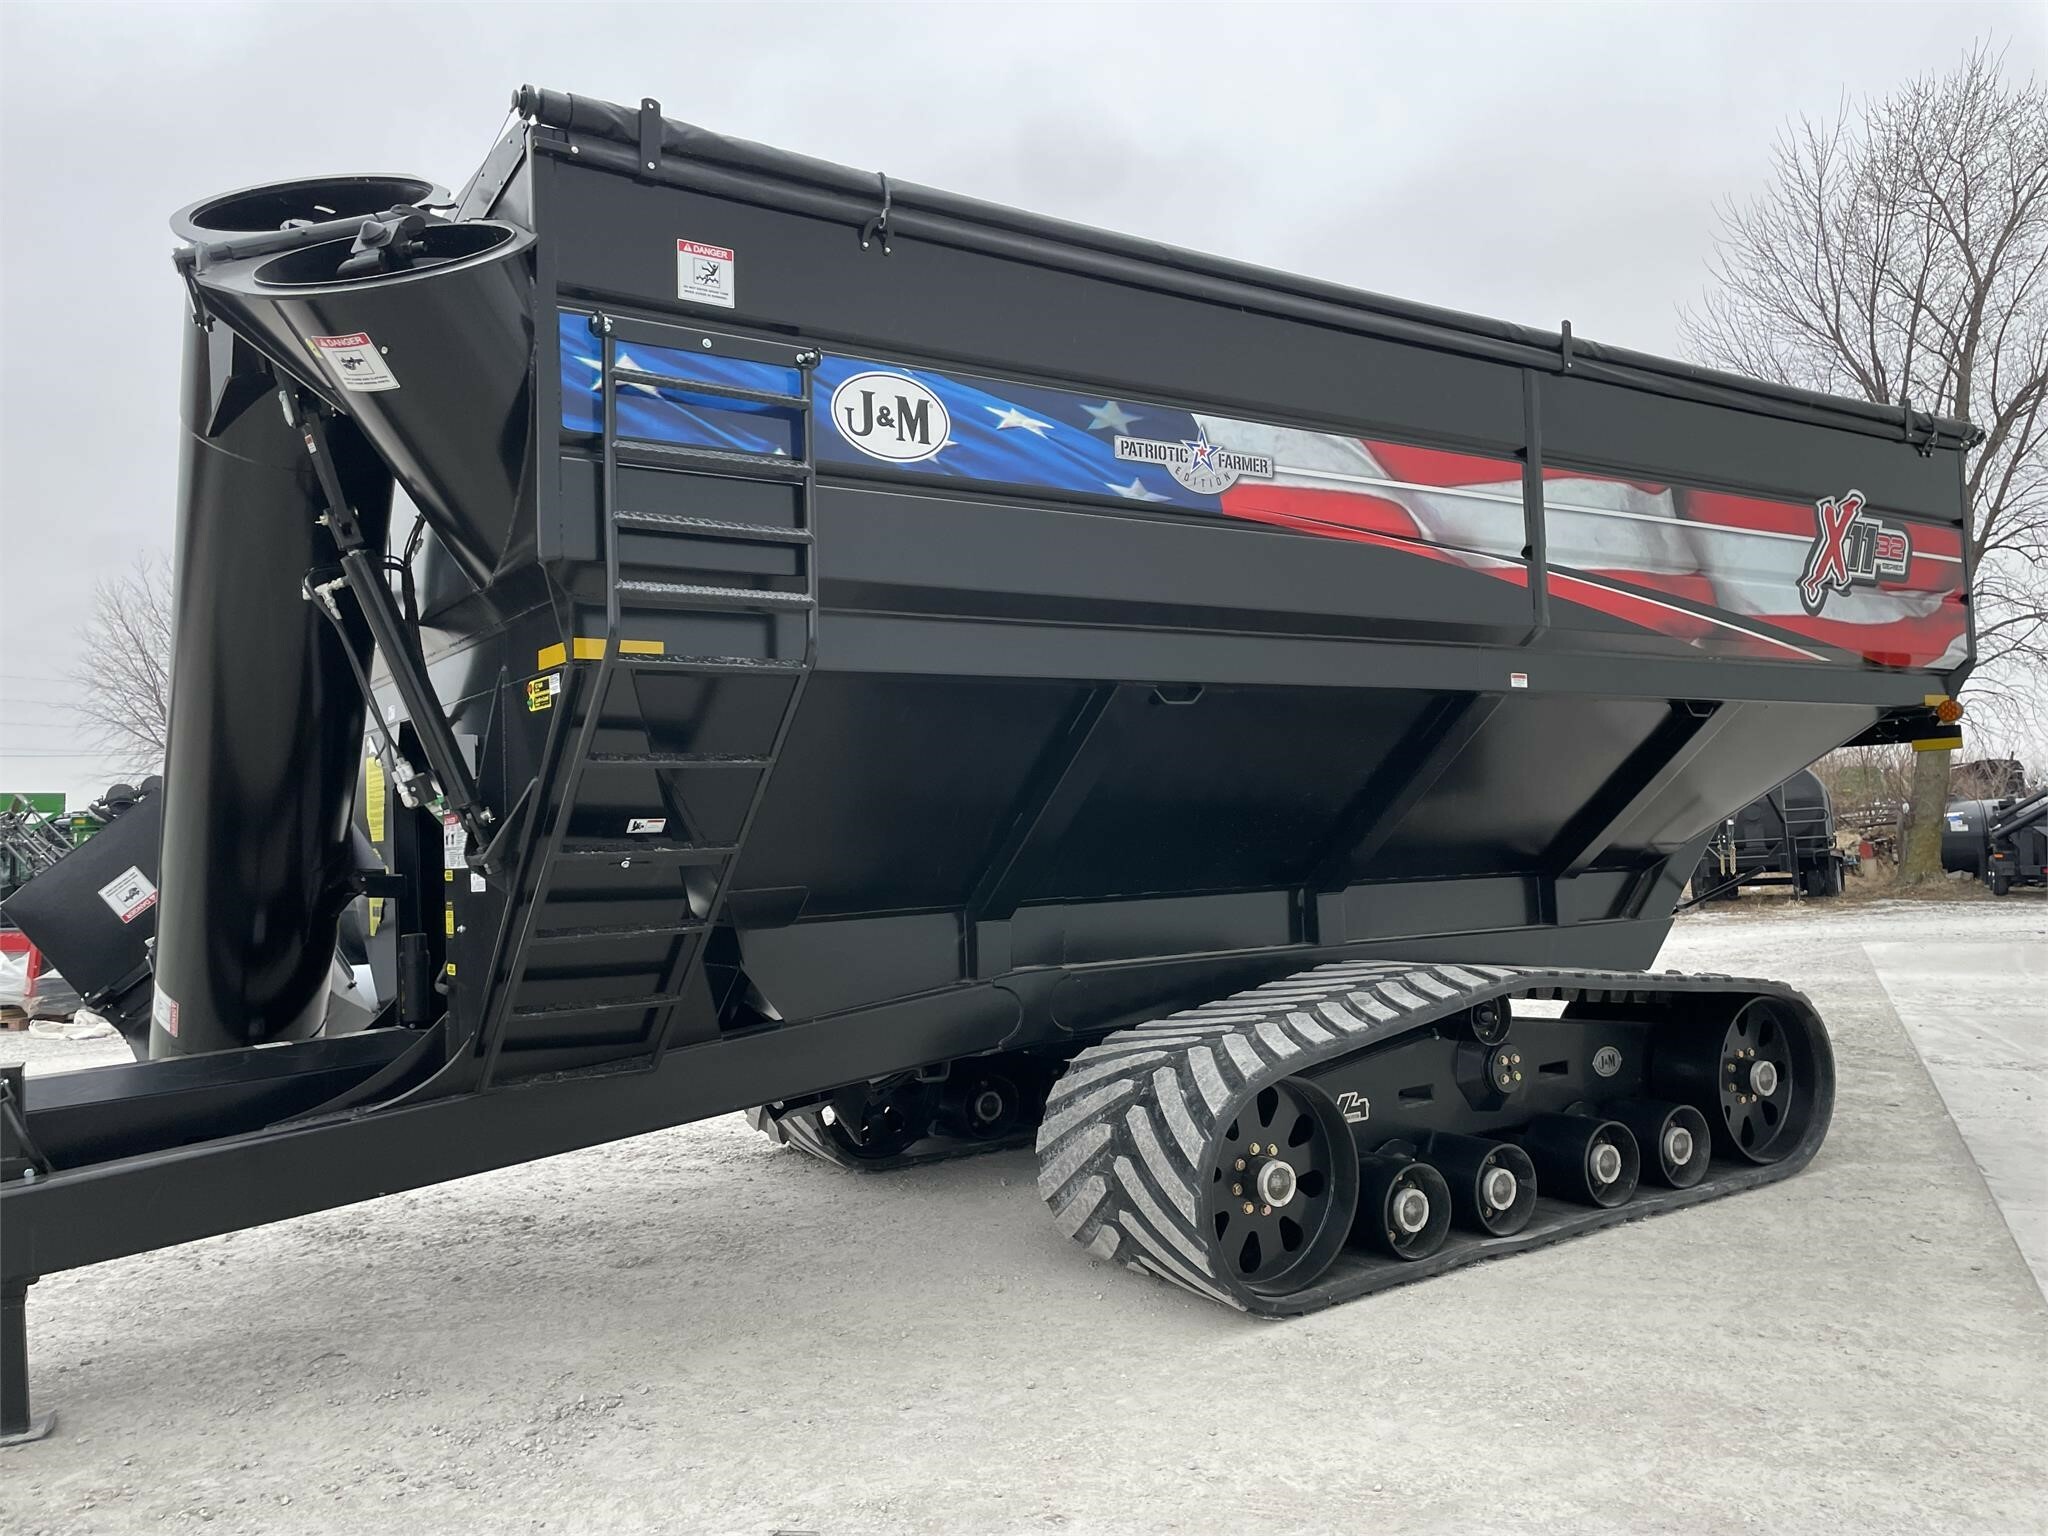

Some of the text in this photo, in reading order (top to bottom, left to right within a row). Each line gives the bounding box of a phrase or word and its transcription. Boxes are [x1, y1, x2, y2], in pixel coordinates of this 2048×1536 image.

[693, 244, 729, 259] DANGER
[327, 336, 364, 348] DANGER
[844, 390, 932, 446] J&M
[1120, 440, 1268, 474] PATRIOTIC FARMER
[1175, 466, 1231, 488] EDITION
[126, 898, 153, 919] DANGER
